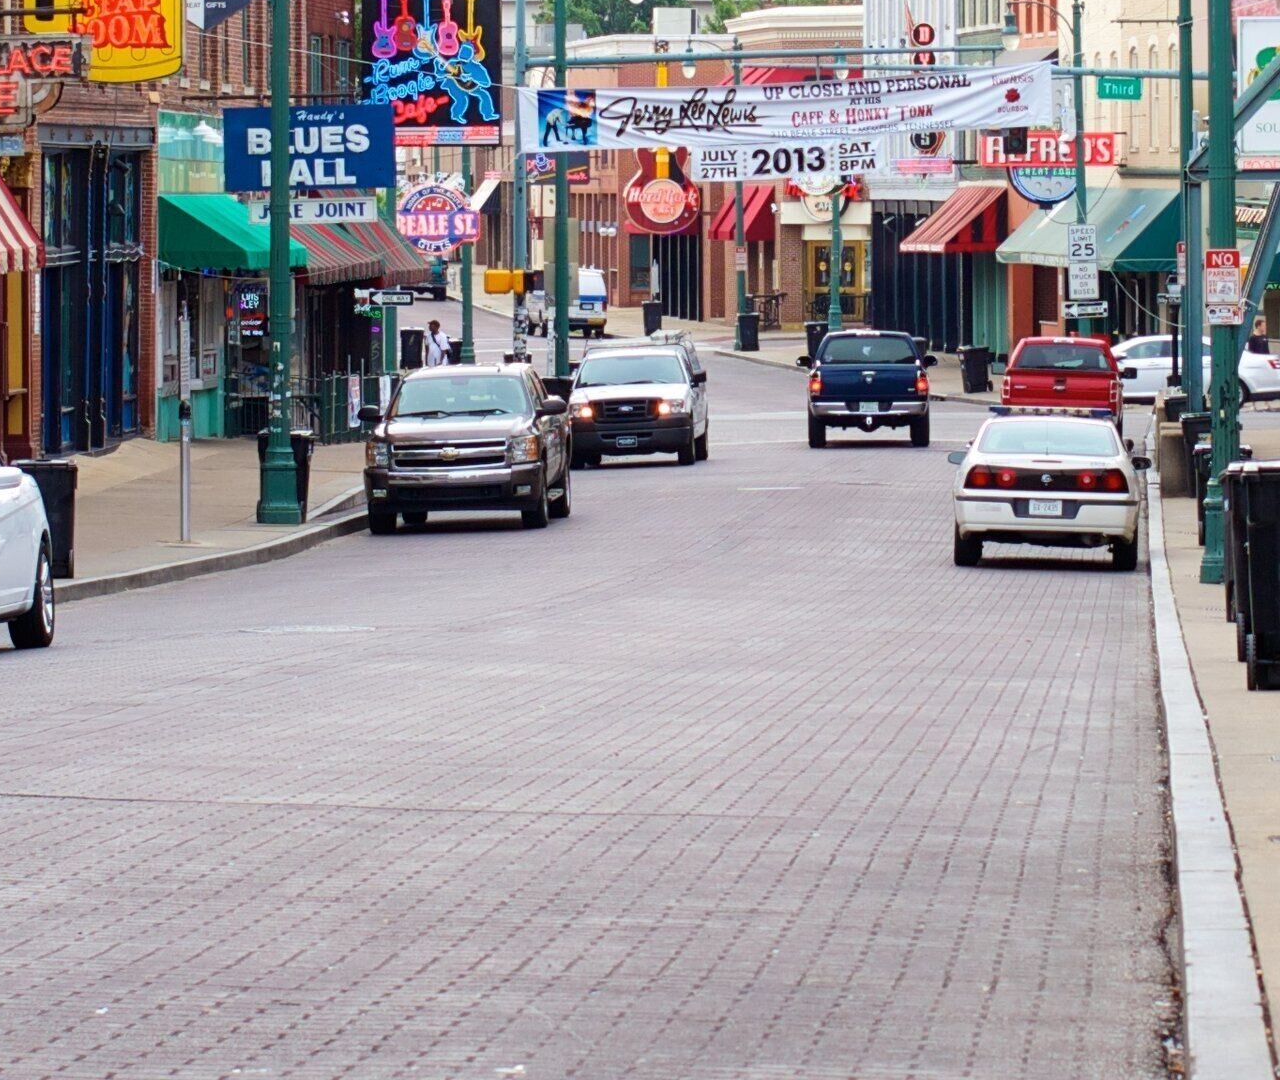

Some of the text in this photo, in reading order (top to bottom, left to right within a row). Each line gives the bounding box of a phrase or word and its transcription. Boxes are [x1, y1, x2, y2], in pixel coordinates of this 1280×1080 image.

[763, 73, 971, 100] UP CLOSE AND PERSONAL
[1103, 83, 1134, 95] Third
[850, 96, 881, 106] AT HIS
[296, 110, 345, 123] Handy's
[599, 88, 757, 137] Jerry Lee Lewis
[791, 104, 934, 127] CAFE & HONKY TONK
[904, 121, 955, 130] TENNESSEE
[838, 142, 875, 155] SAT.
[700, 150, 737, 162] JULY
[751, 146, 825, 175] 2013
[839, 158, 876, 171] 8PM
[701, 168, 737, 179] 27TH
[315, 202, 366, 218] JOINT
[455, 214, 477, 236] ST.
[1072, 244, 1094, 256] 25
[1212, 253, 1233, 265] NO
[1071, 273, 1096, 281] TRUCKS
[1074, 288, 1095, 296] BUSES
